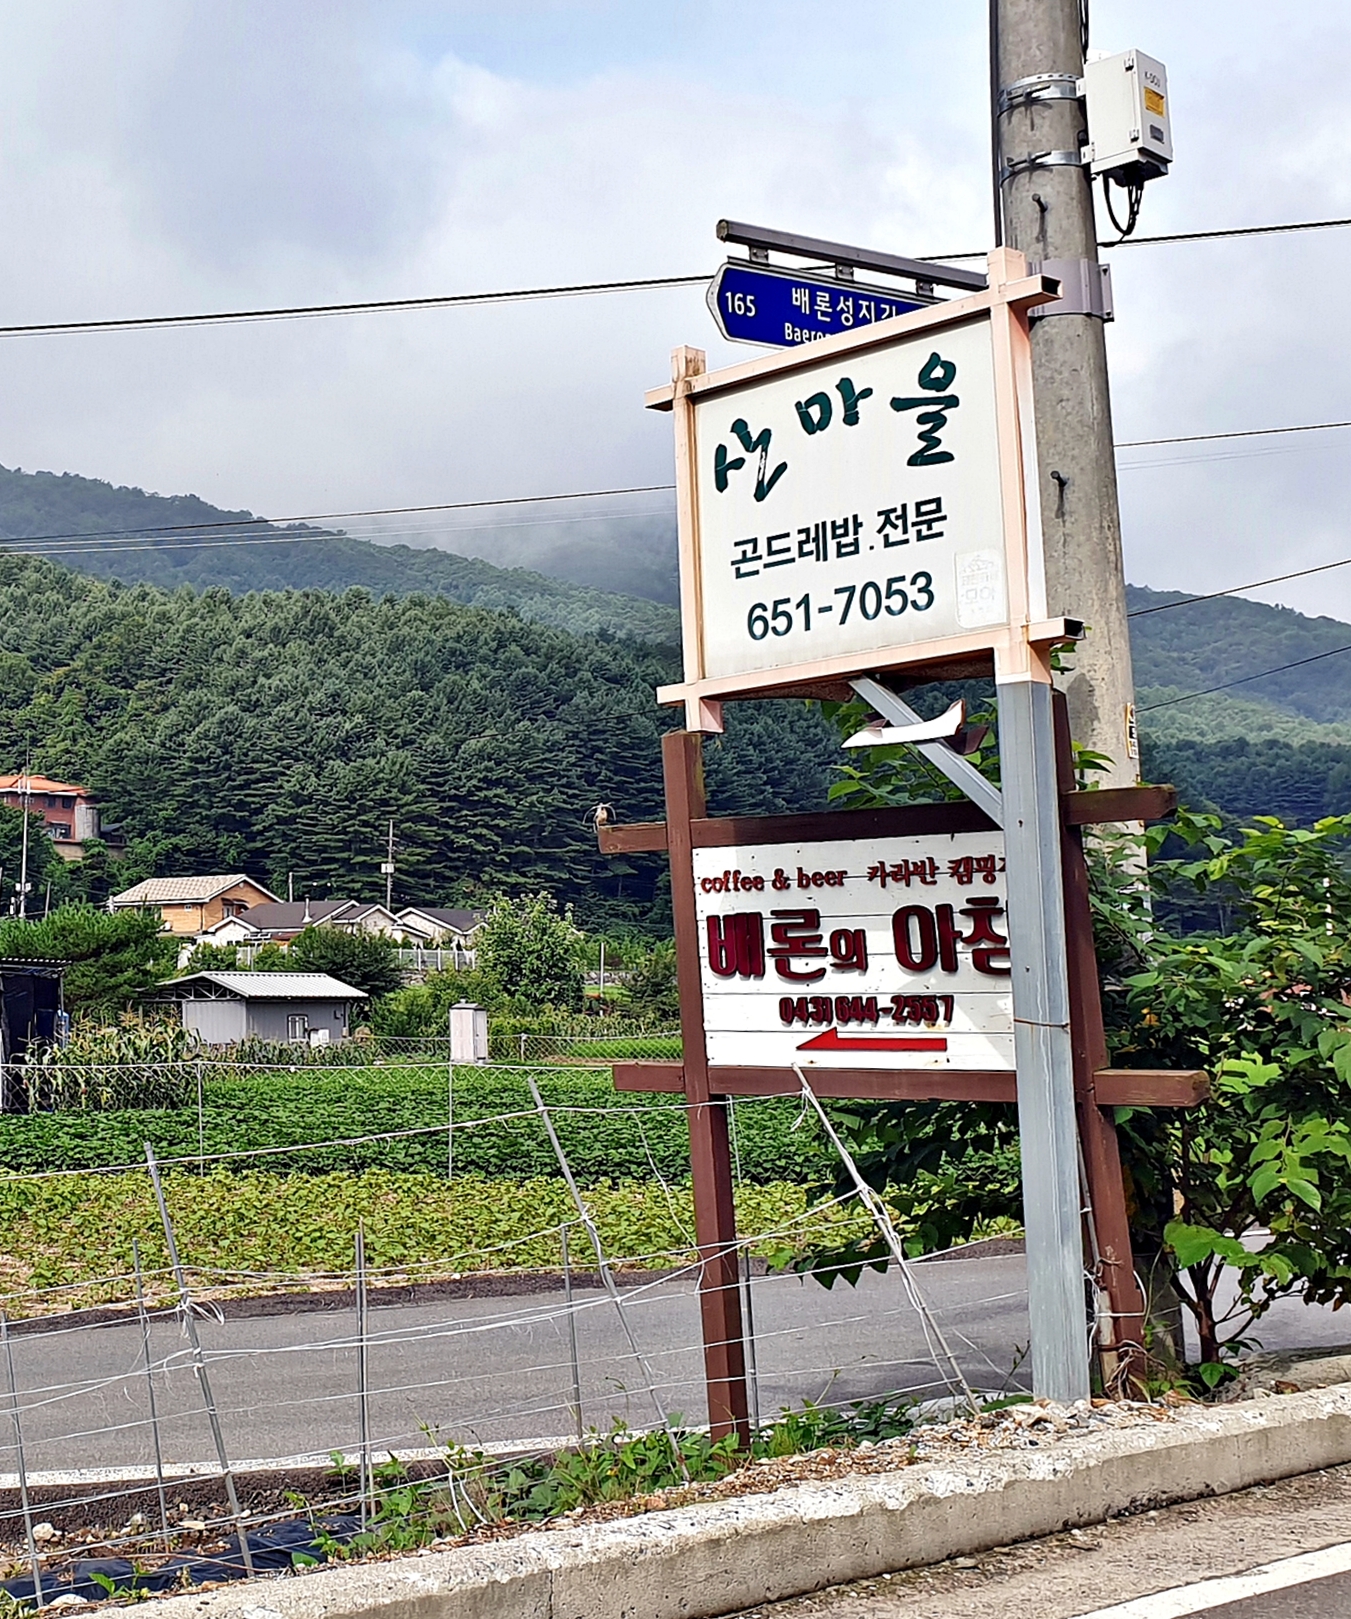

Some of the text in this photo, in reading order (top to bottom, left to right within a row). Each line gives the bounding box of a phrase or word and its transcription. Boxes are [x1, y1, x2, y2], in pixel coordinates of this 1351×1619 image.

[725, 291, 757, 317] 165
[714, 352, 960, 502] 산마을
[747, 571, 935, 640] 651-7053
[700, 870, 765, 893] coffee
[771, 868, 791, 891] &
[796, 867, 848, 888] beer
[867, 857, 940, 888] 카라반
[706, 908, 868, 979] 배론의
